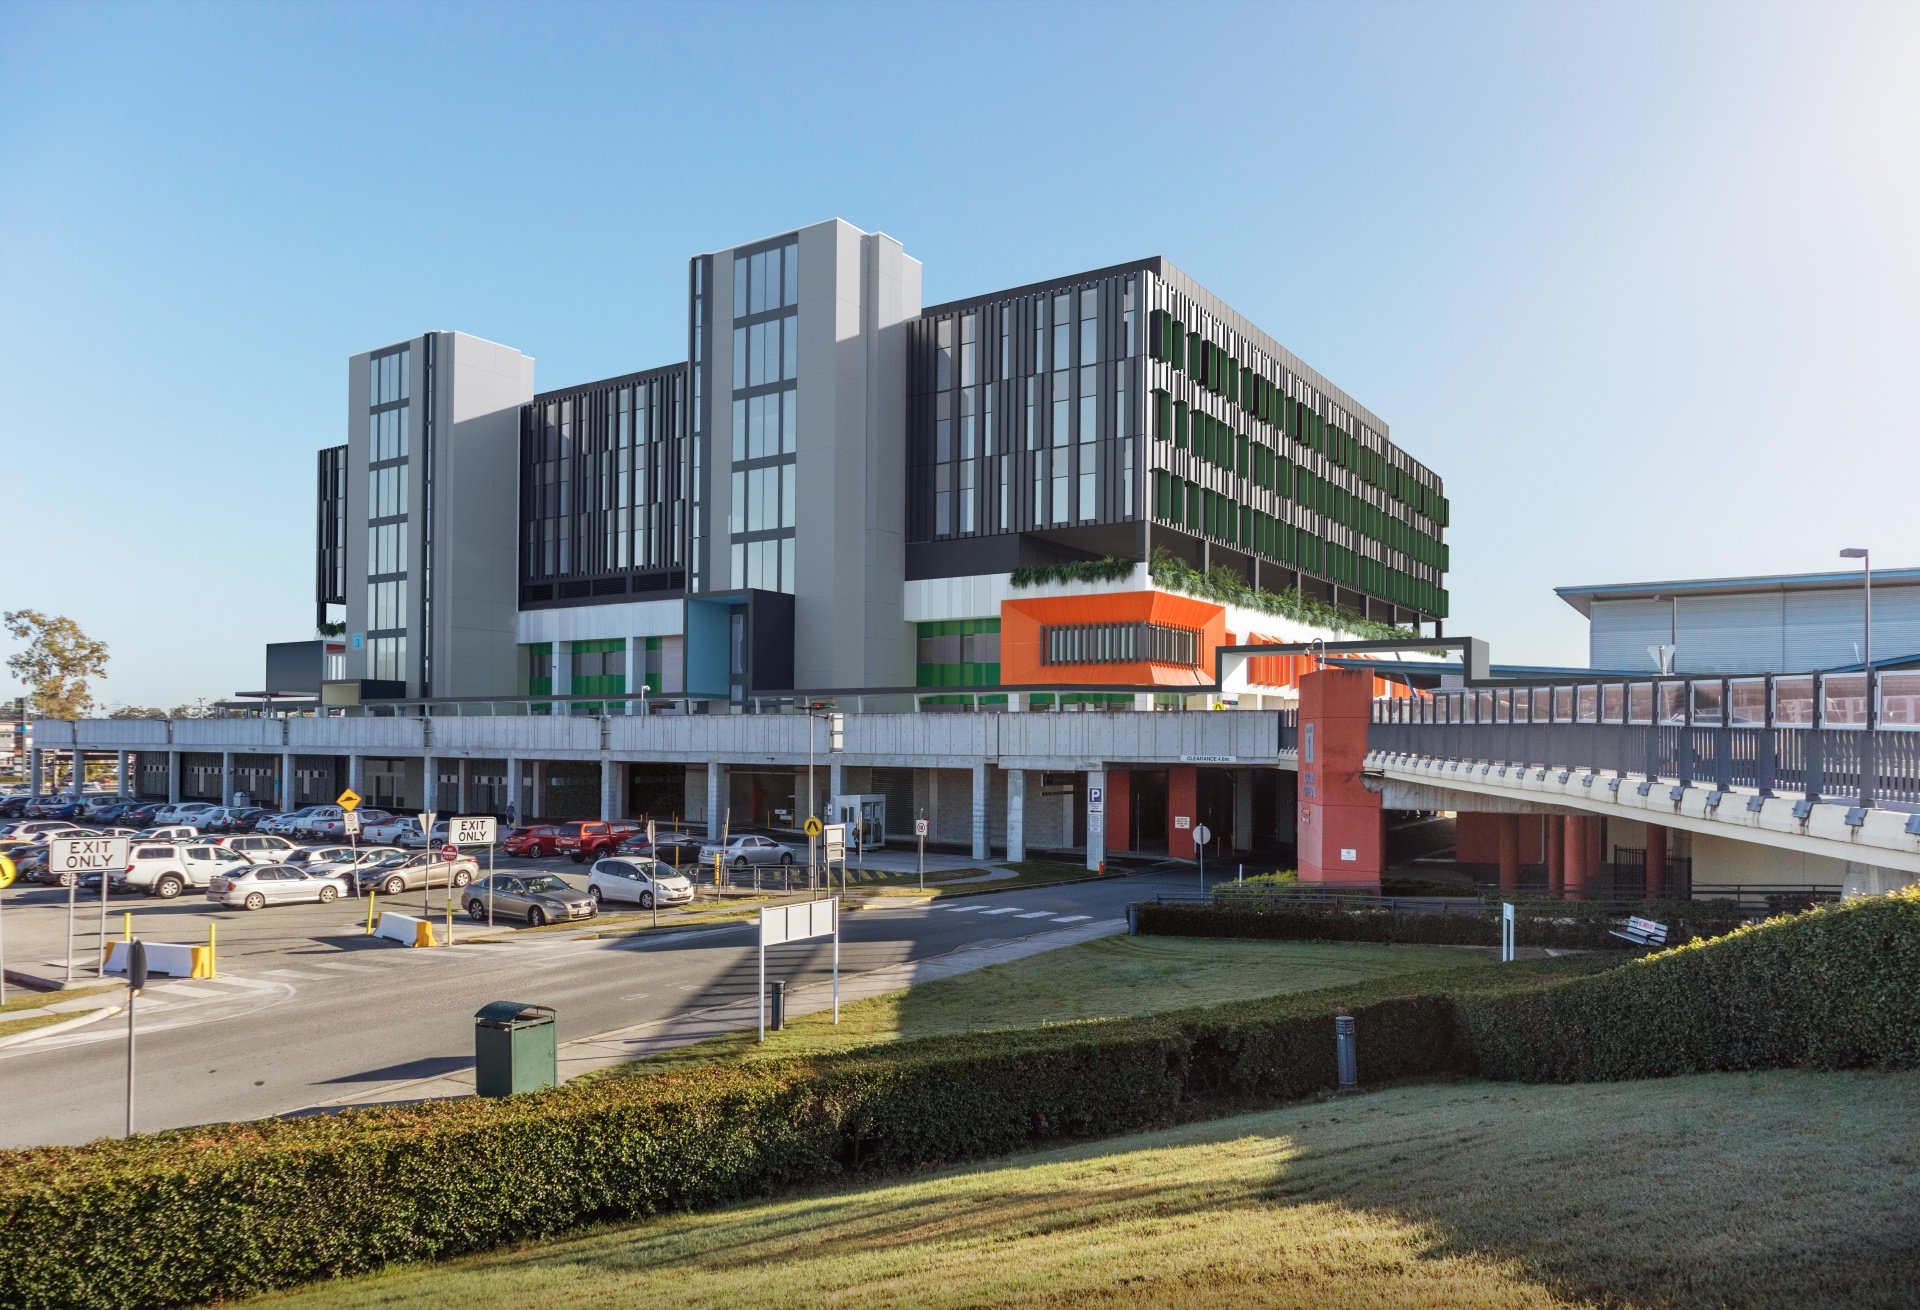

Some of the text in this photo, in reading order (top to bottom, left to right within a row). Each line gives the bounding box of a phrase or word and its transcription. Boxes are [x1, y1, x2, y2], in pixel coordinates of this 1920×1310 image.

[355, 638, 360, 648] 3
[1091, 789, 1100, 802] P
[461, 820, 486, 831] EXIT
[458, 831, 487, 841] ONLY
[70, 841, 111, 854] EXIT
[66, 854, 114, 868] ONLY
